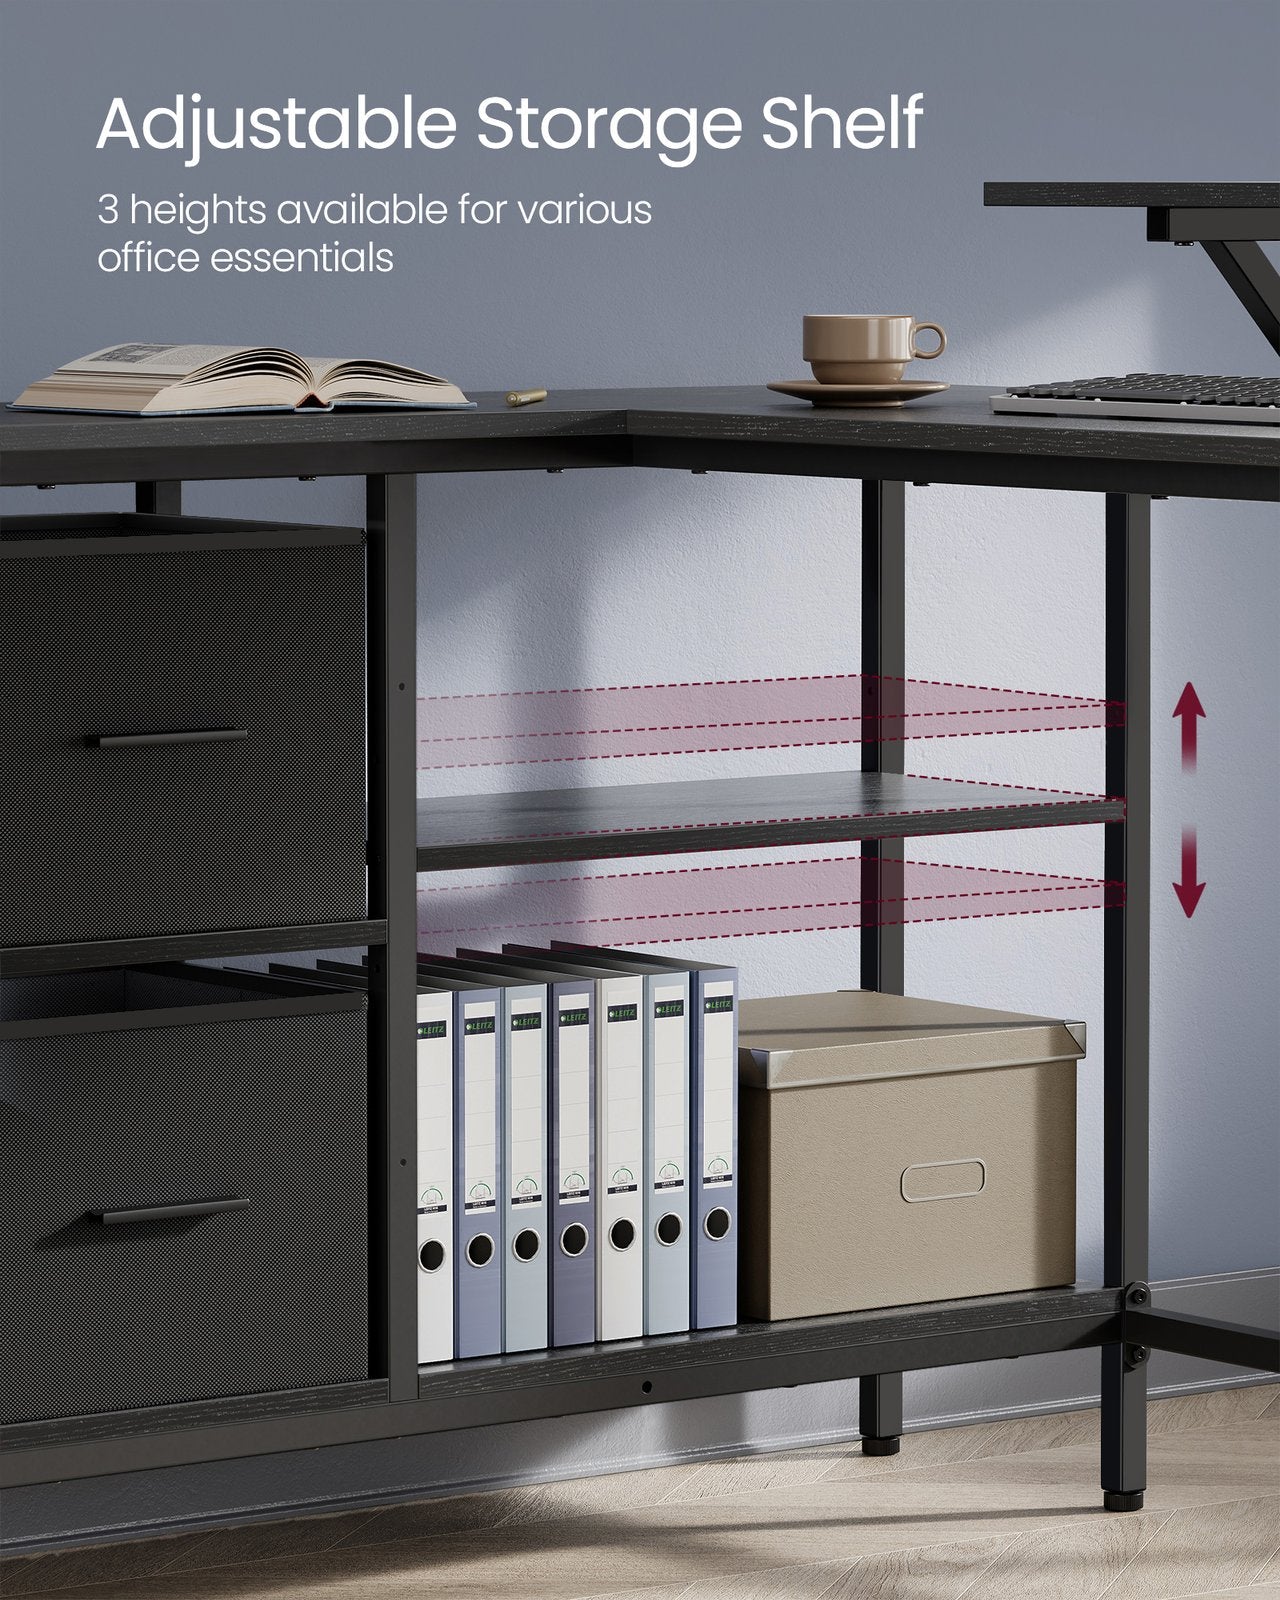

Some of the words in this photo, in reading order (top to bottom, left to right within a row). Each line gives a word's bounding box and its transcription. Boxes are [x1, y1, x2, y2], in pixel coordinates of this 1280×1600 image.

[661, 1004, 682, 1013] LEITZ
[710, 1000, 731, 1009] LEITZ
[614, 1009, 635, 1018] LEITZ
[518, 1018, 539, 1026] LEITZ
[565, 1014, 587, 1023] LEITZ
[423, 1026, 444, 1035] LEITZ
[472, 1022, 494, 1030] LEITZ
